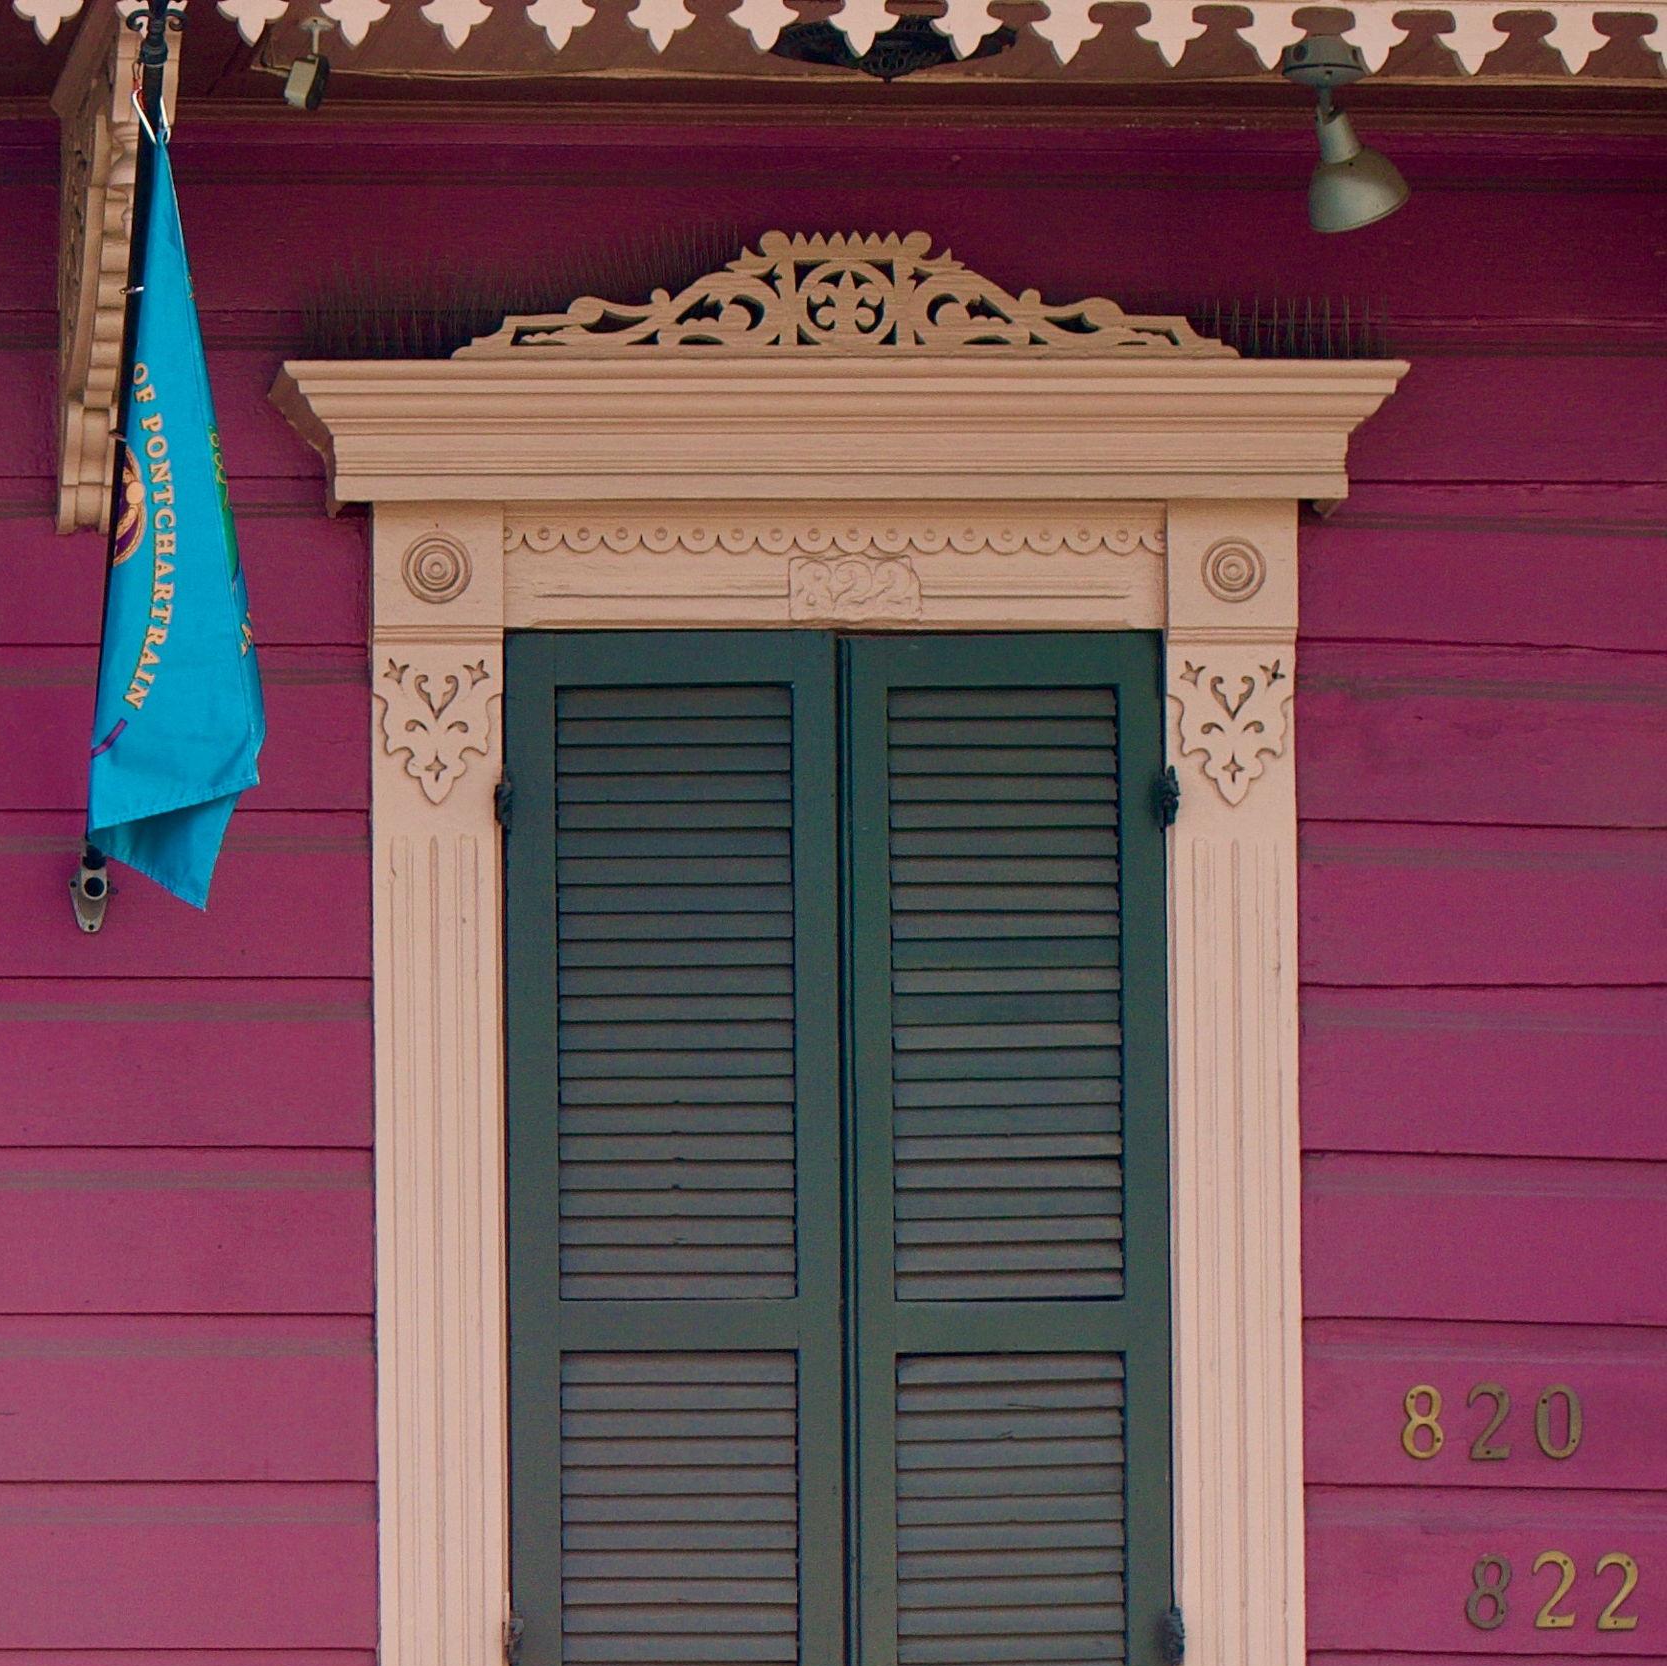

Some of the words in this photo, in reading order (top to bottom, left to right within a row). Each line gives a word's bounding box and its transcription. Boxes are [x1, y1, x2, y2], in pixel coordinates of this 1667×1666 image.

[133, 362, 156, 403] OF
[124, 411, 176, 711] PONTCHARTRAIN
[796, 559, 915, 617] 822
[1401, 1384, 1584, 1460] 820
[1465, 1550, 1639, 1630] 822
